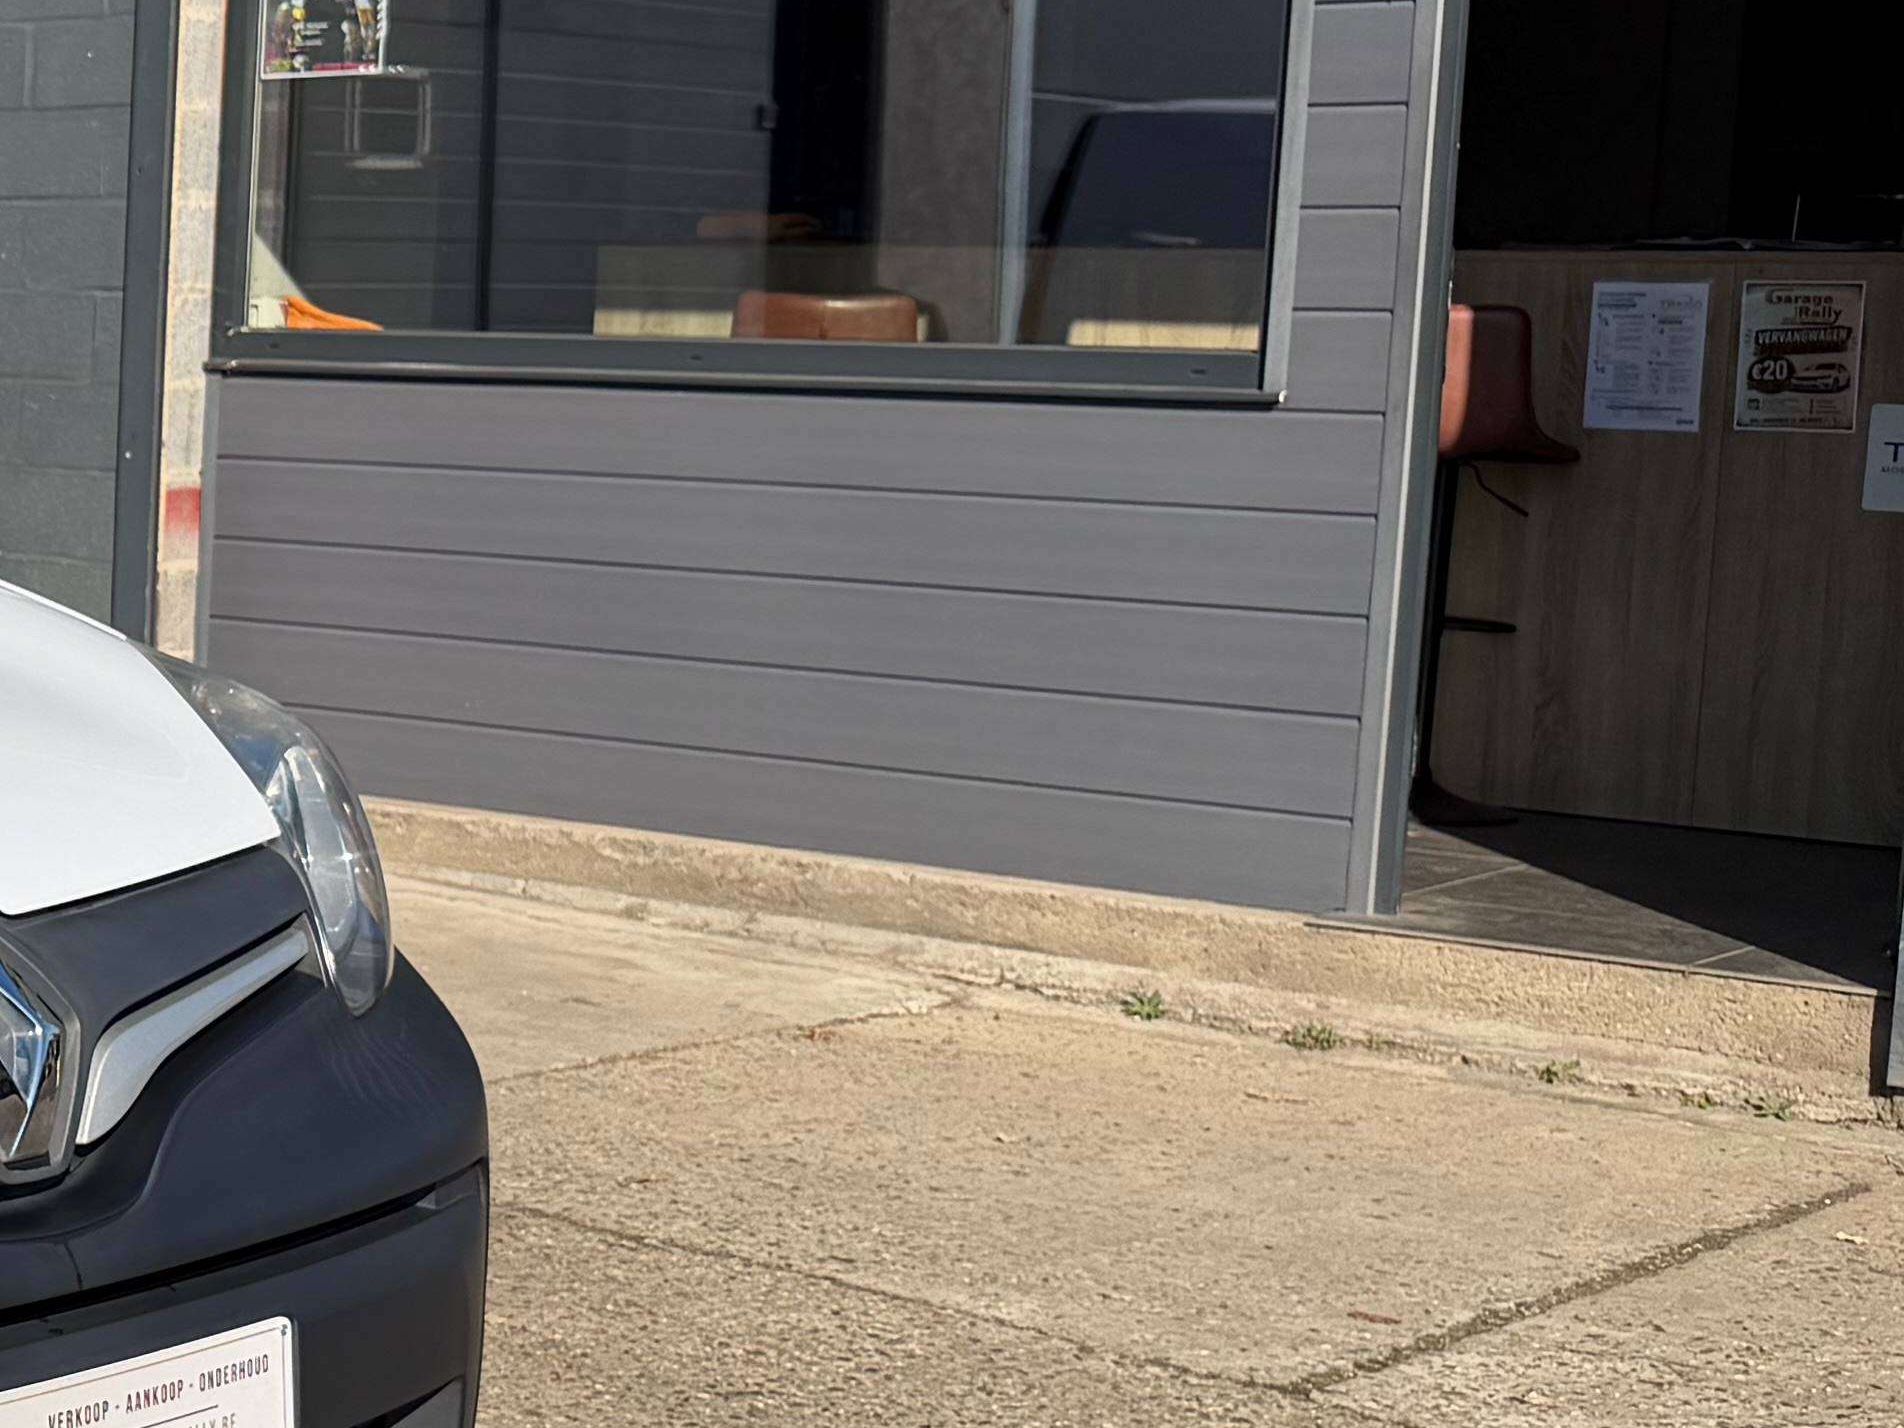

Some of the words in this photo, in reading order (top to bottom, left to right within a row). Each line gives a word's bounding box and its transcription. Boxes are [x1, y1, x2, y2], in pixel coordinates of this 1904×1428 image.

[1765, 289, 1834, 305] Garage
[1799, 306, 1843, 324] Rally
[125, 1379, 184, 1414] AANKOOP
[199, 1354, 270, 1392] ONDERHOUD
